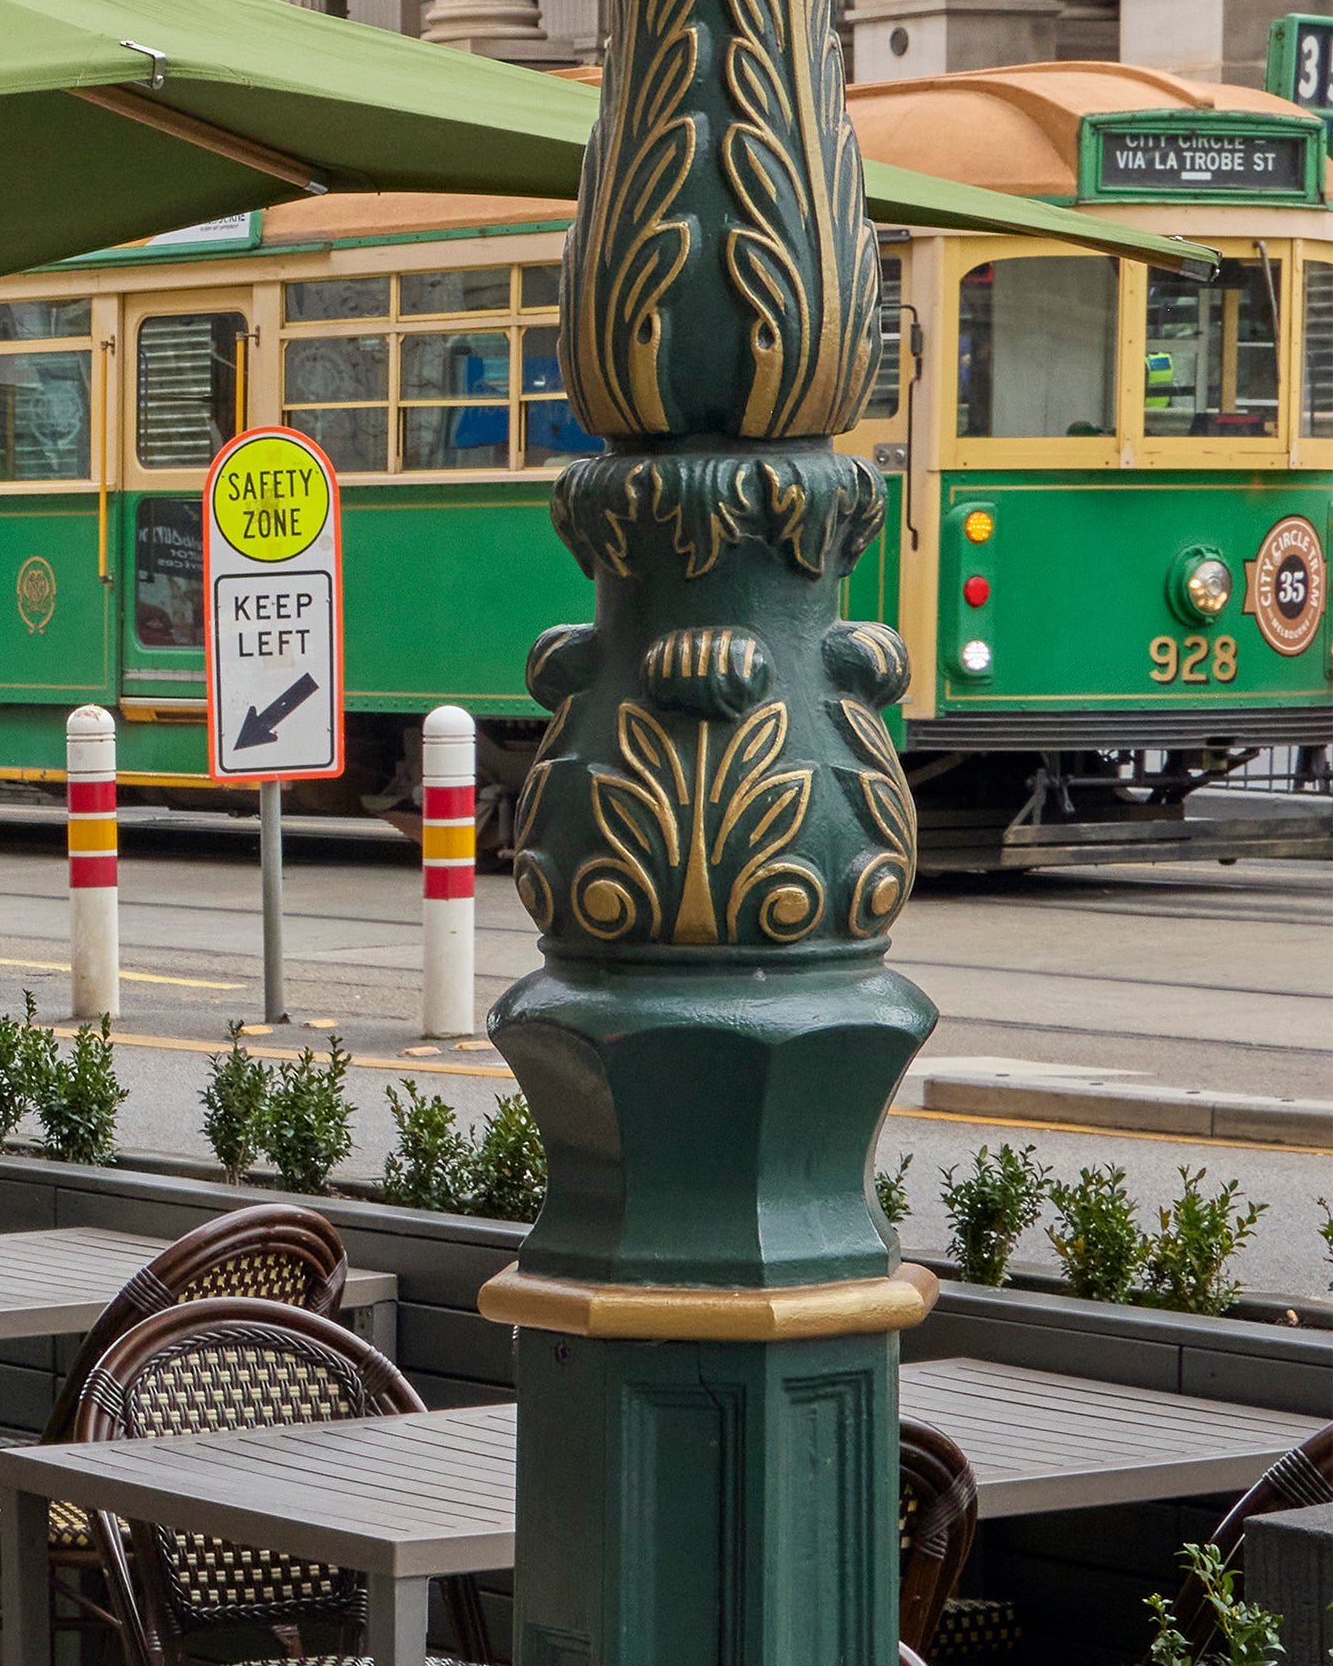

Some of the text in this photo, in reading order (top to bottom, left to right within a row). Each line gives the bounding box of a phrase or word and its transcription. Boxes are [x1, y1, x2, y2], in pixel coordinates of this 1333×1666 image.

[1298, 35, 1333, 99] 3
[1116, 151, 1276, 171] VIA LA TROBE ST
[228, 468, 313, 501] SAFETY
[243, 508, 302, 539] ZONE
[1260, 529, 1321, 607] CITY CIRCLE TRAM
[1278, 571, 1305, 603] 35
[234, 593, 313, 621] KEEP
[239, 629, 310, 657] LEFT
[1148, 635, 1239, 684] 928
